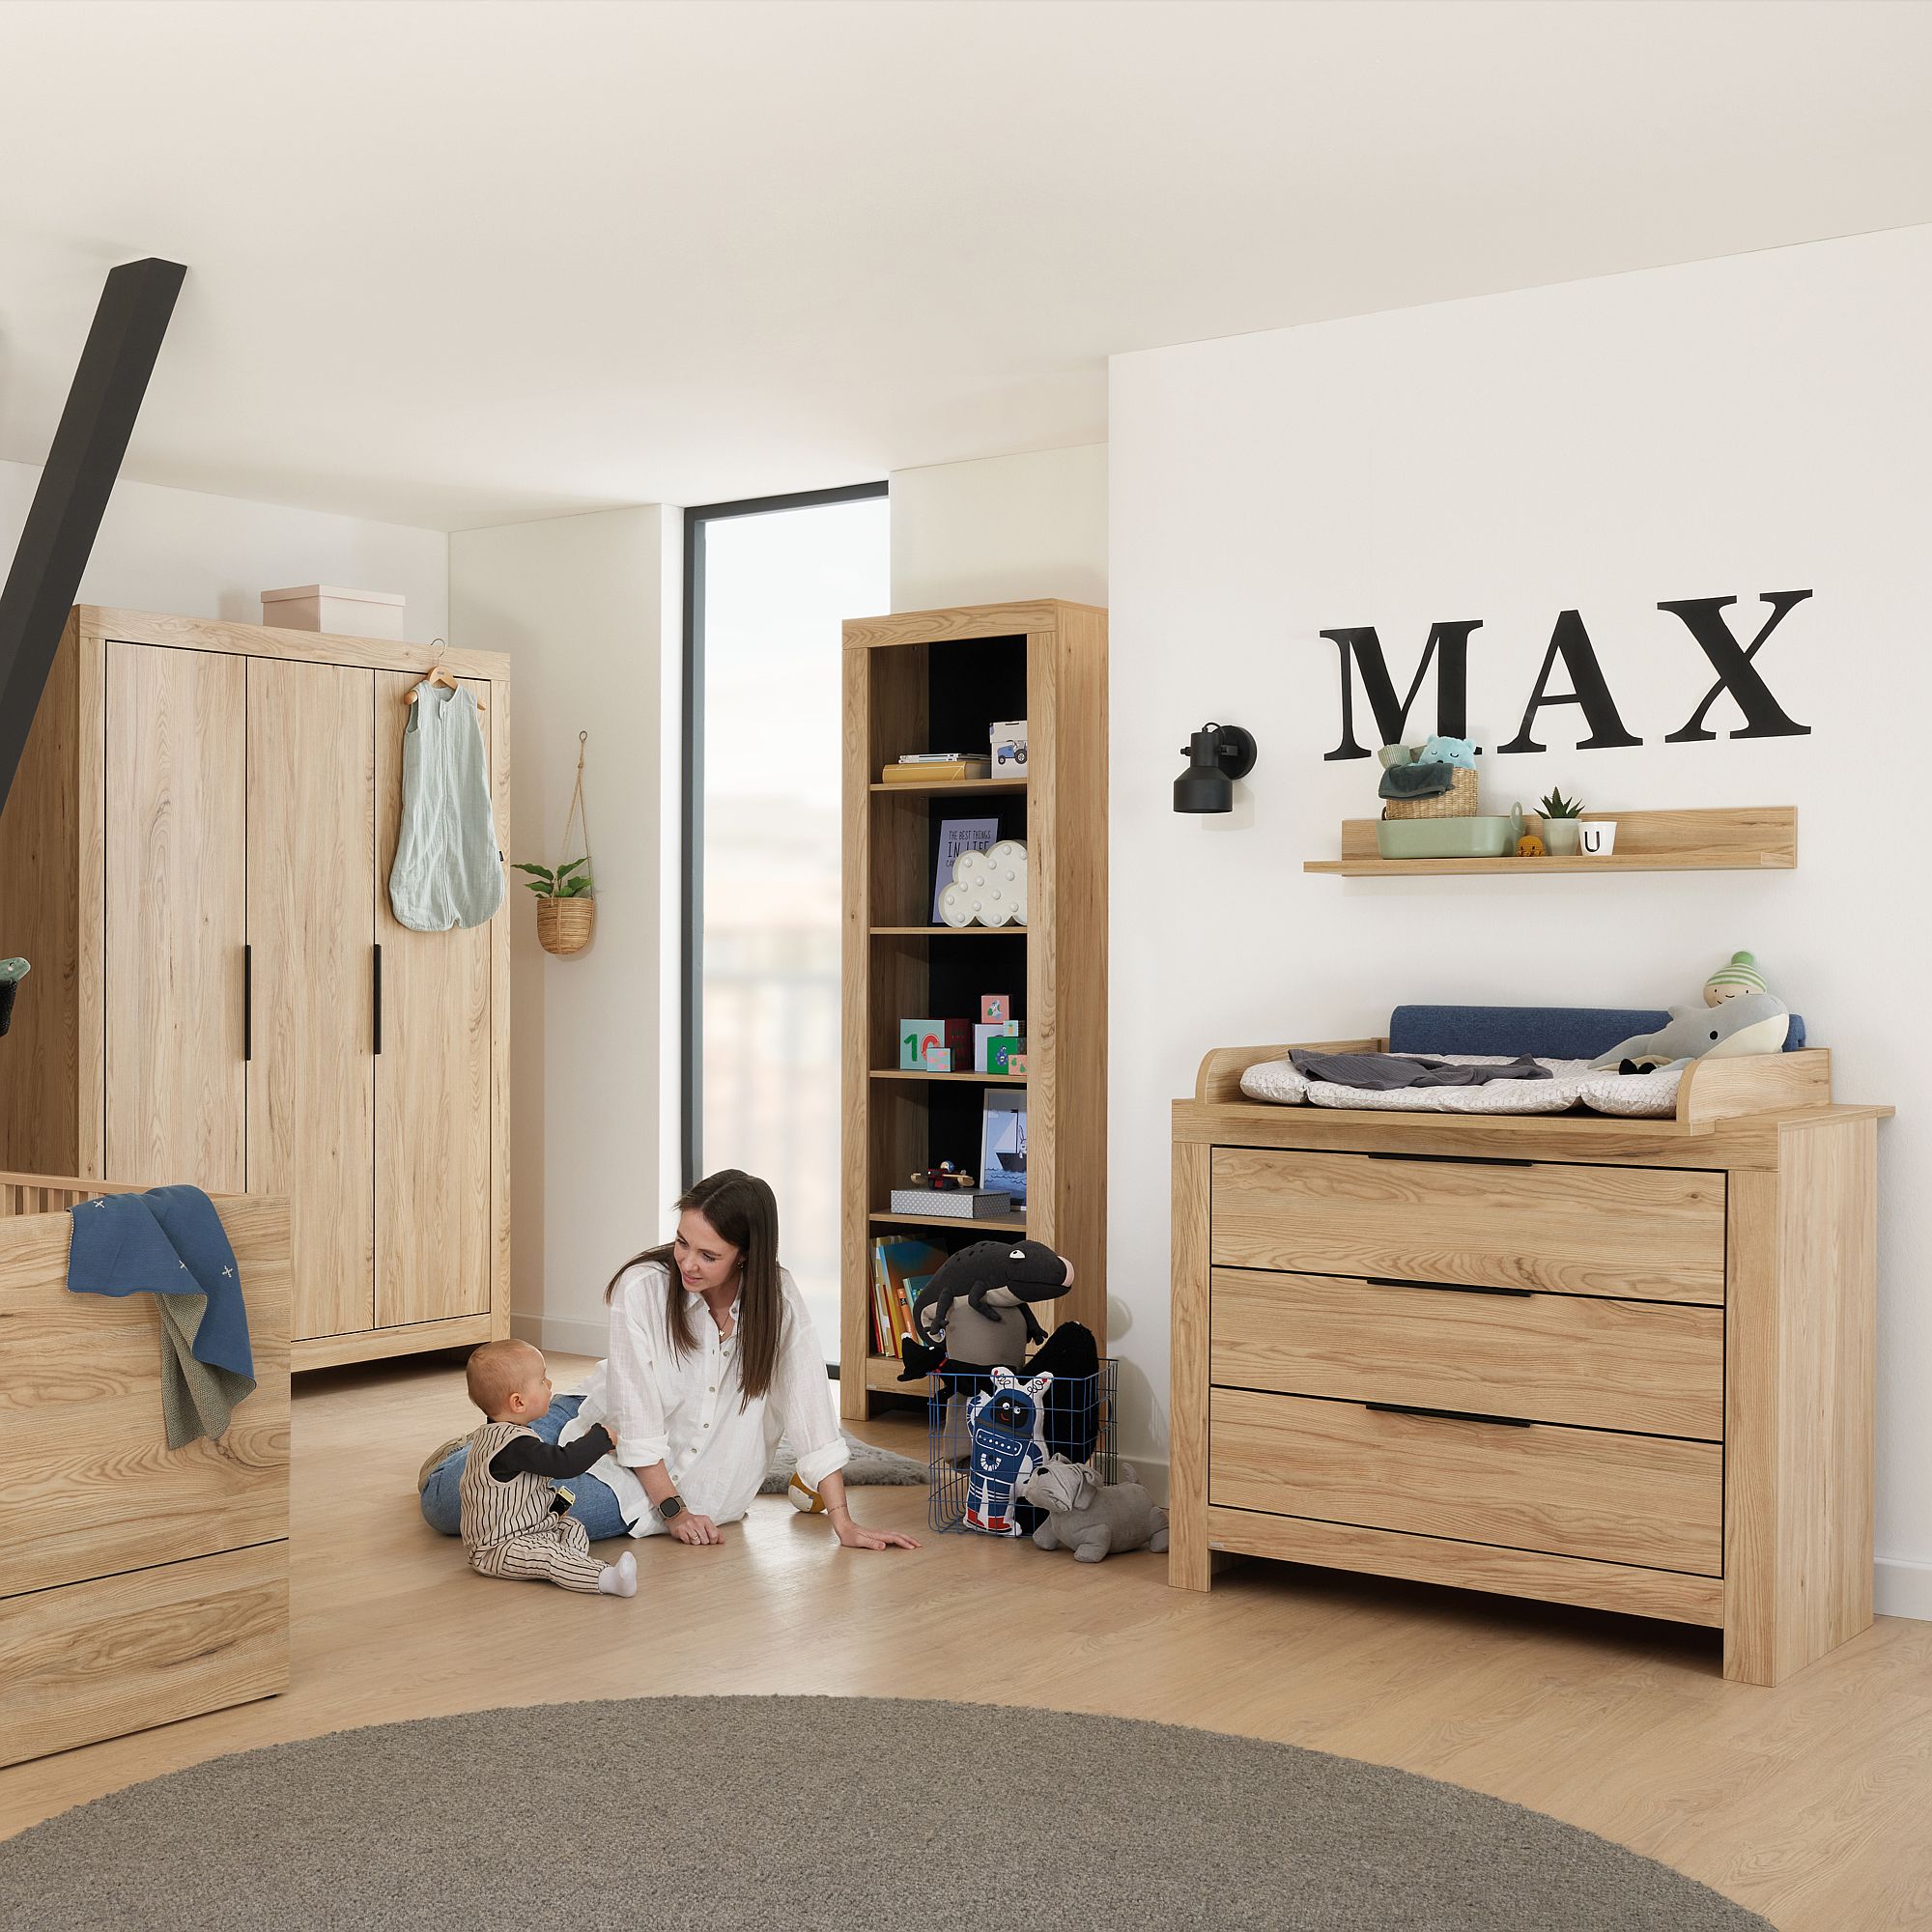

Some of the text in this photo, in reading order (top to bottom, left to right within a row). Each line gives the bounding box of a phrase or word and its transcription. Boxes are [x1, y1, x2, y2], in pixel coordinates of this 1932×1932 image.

[1320, 589, 1813, 761] MAX
[949, 830, 991, 840] THE BEST THINGS
[1584, 831, 1601, 853] U
[948, 841, 961, 858] IN
